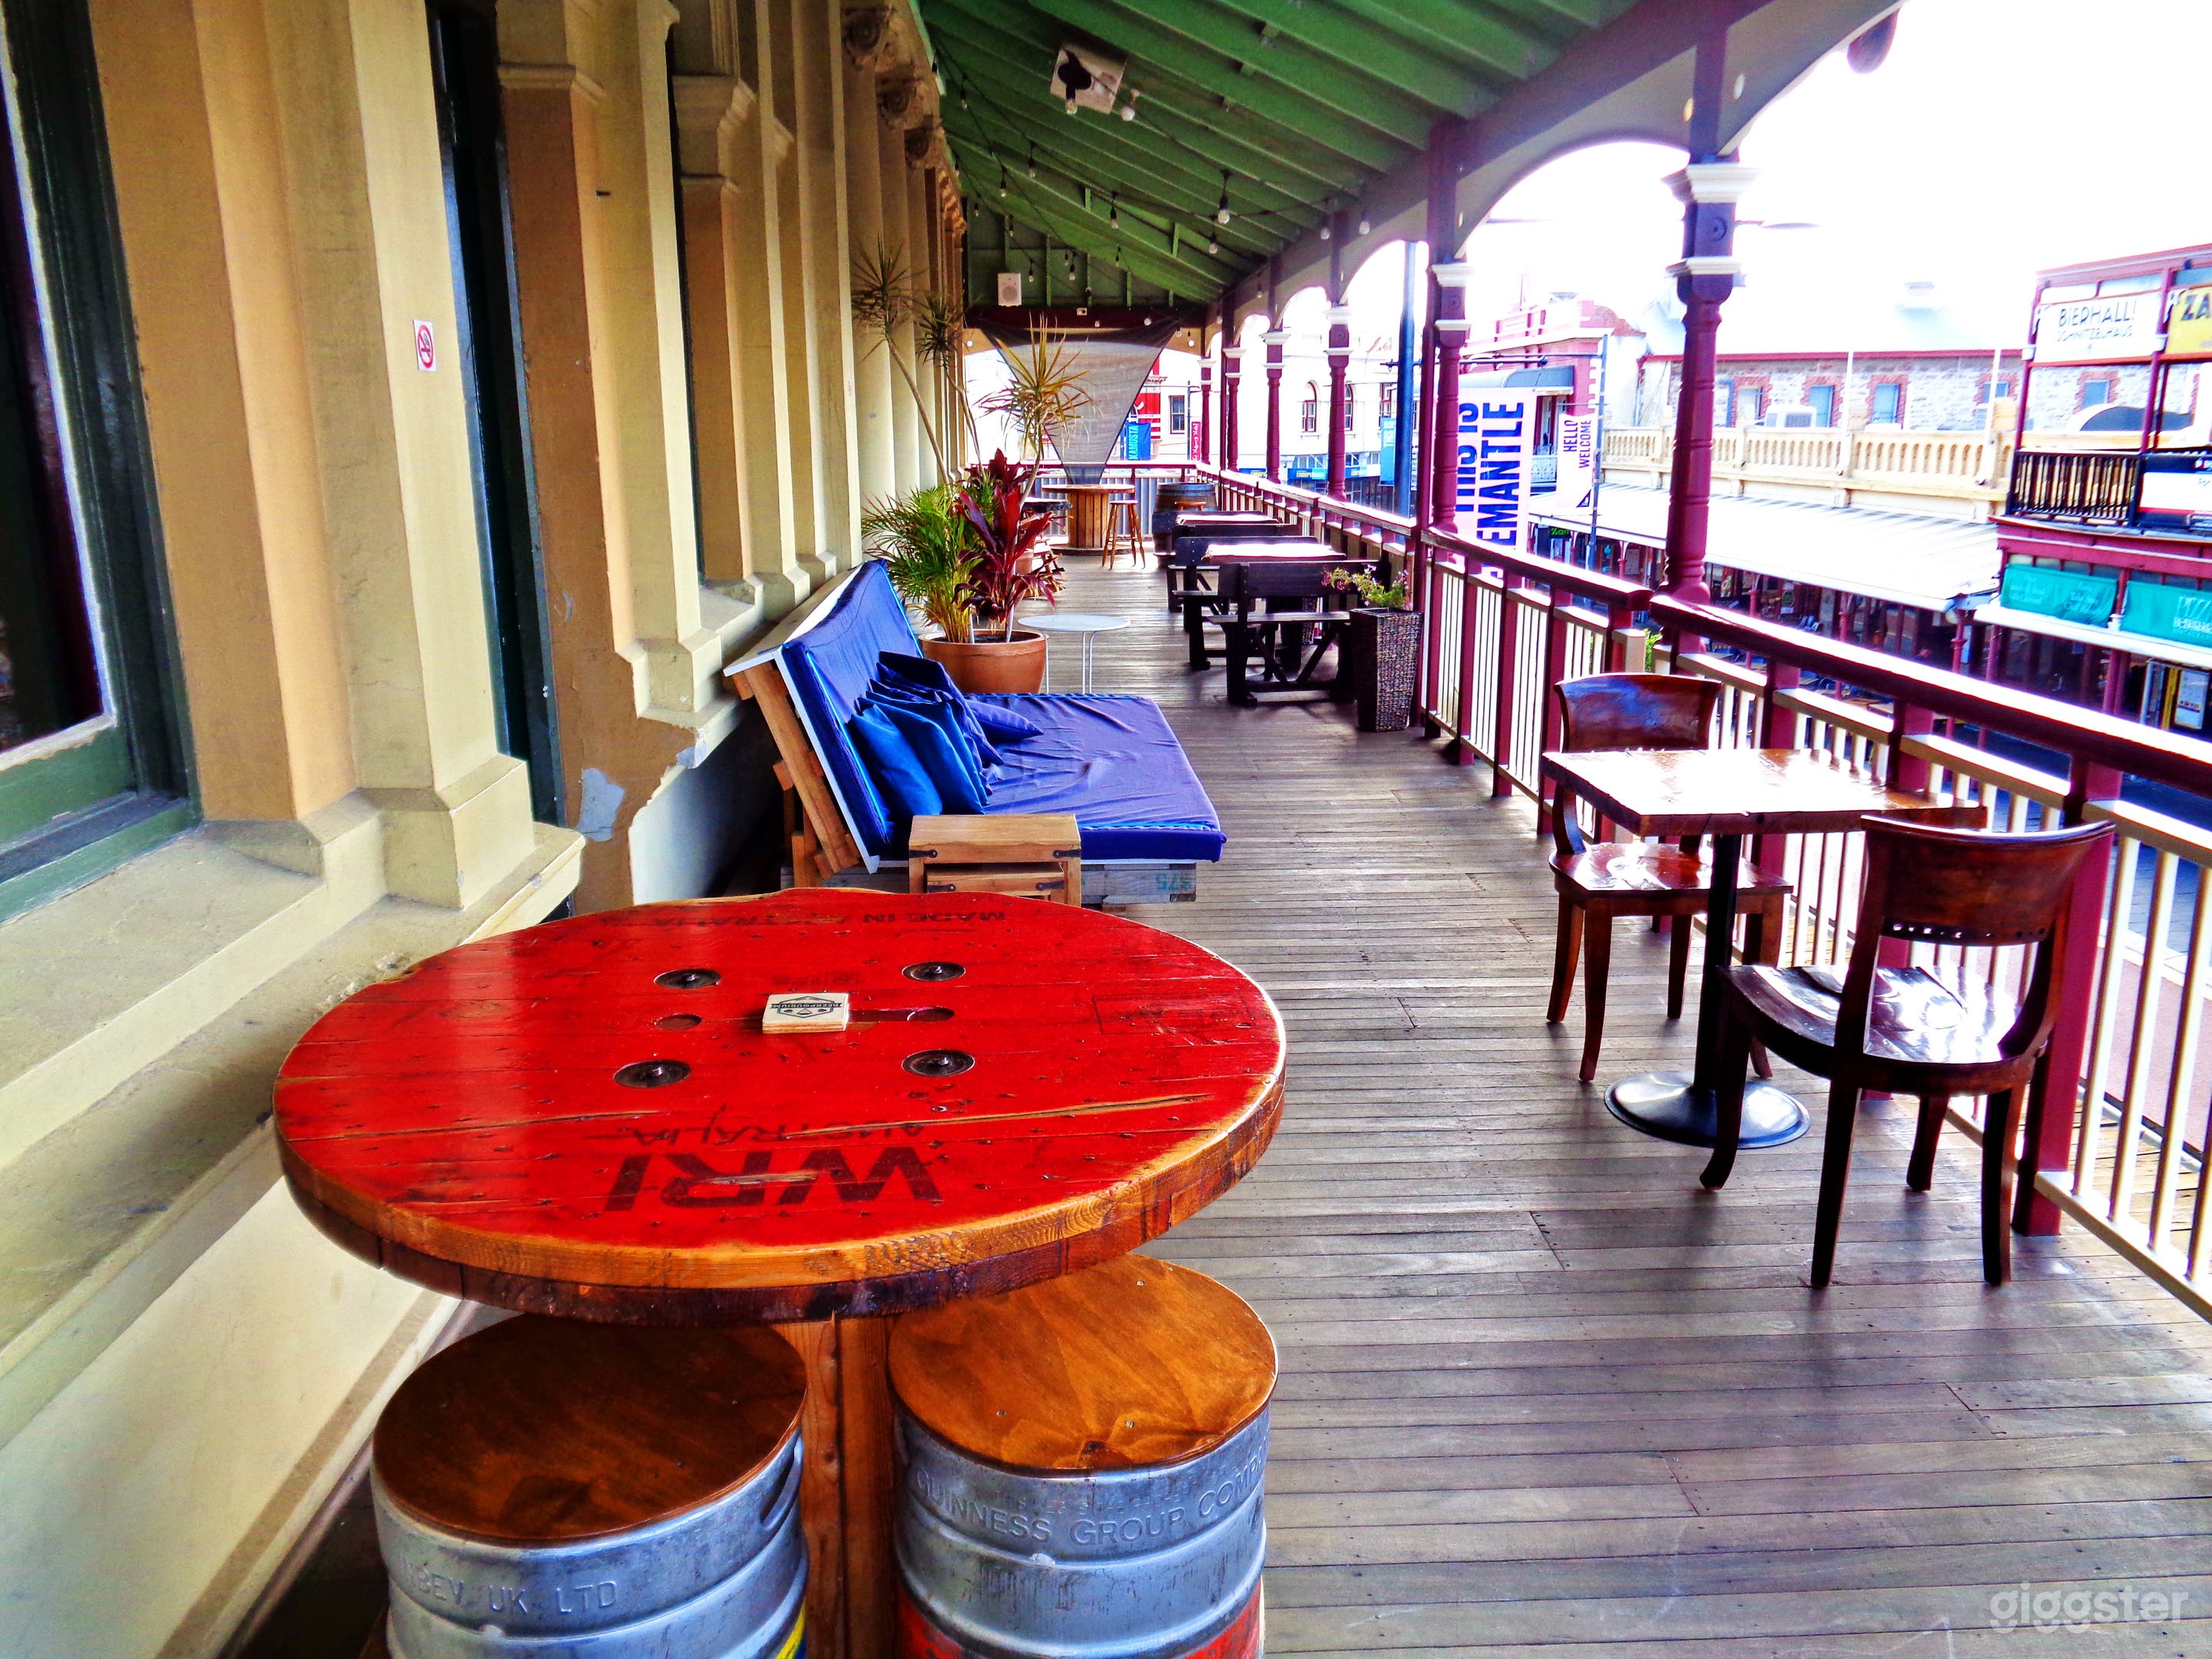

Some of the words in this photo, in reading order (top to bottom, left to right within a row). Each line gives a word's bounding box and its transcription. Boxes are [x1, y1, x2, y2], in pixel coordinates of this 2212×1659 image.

[1128, 425, 1138, 460] KAMUSTA
[1563, 419, 1578, 452] HELLO
[1578, 419, 1592, 469] WELCOME
[1476, 402, 1524, 546] EMANTLE
[2175, 596, 2212, 622] PIZZ
[864, 912, 896, 923] IN
[602, 1146, 942, 1213] WRI
[915, 1468, 1051, 1543] GUINNESS
[1069, 1506, 1185, 1545] GROUP
[489, 1584, 528, 1614] UK
[556, 1580, 617, 1614] LTD
